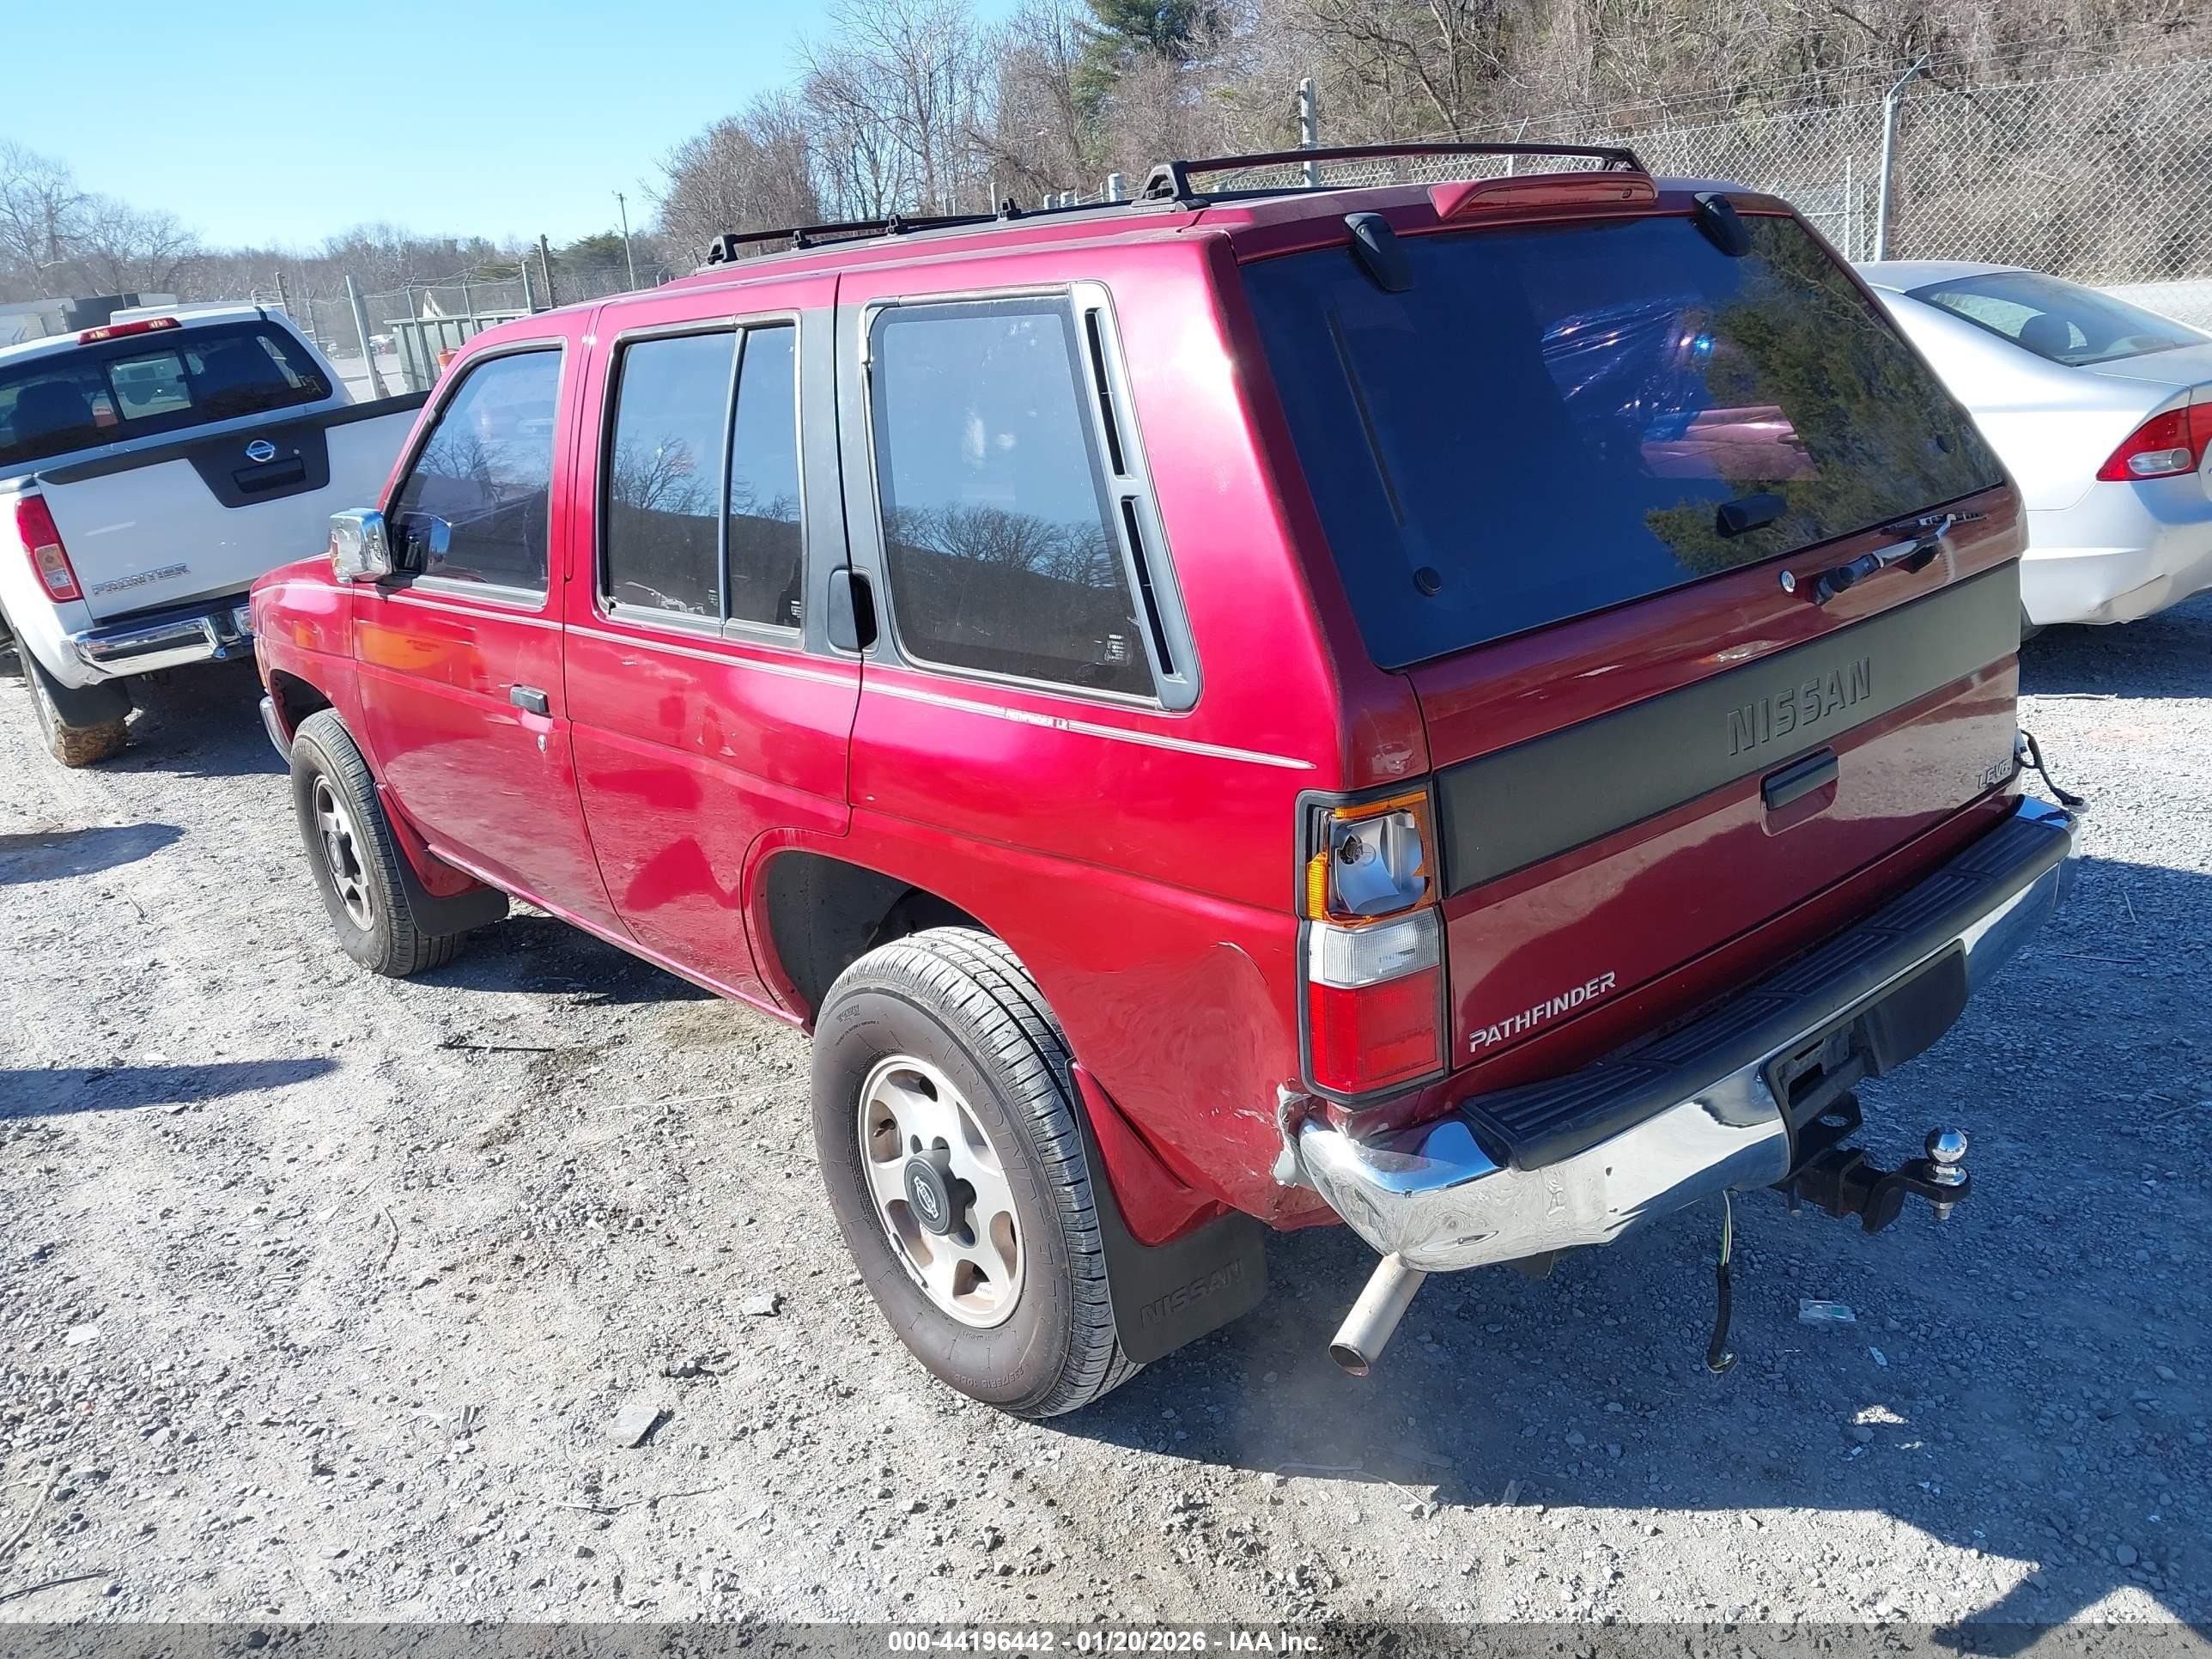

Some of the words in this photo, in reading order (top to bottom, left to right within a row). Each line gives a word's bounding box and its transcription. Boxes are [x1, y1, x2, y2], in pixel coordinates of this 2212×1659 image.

[91, 563, 191, 596] FRONTIER
[1728, 657, 1870, 756] NISSAN
[1469, 970, 1616, 1053] PATHFINDER
[1140, 1258, 1243, 1328] NISSAN
